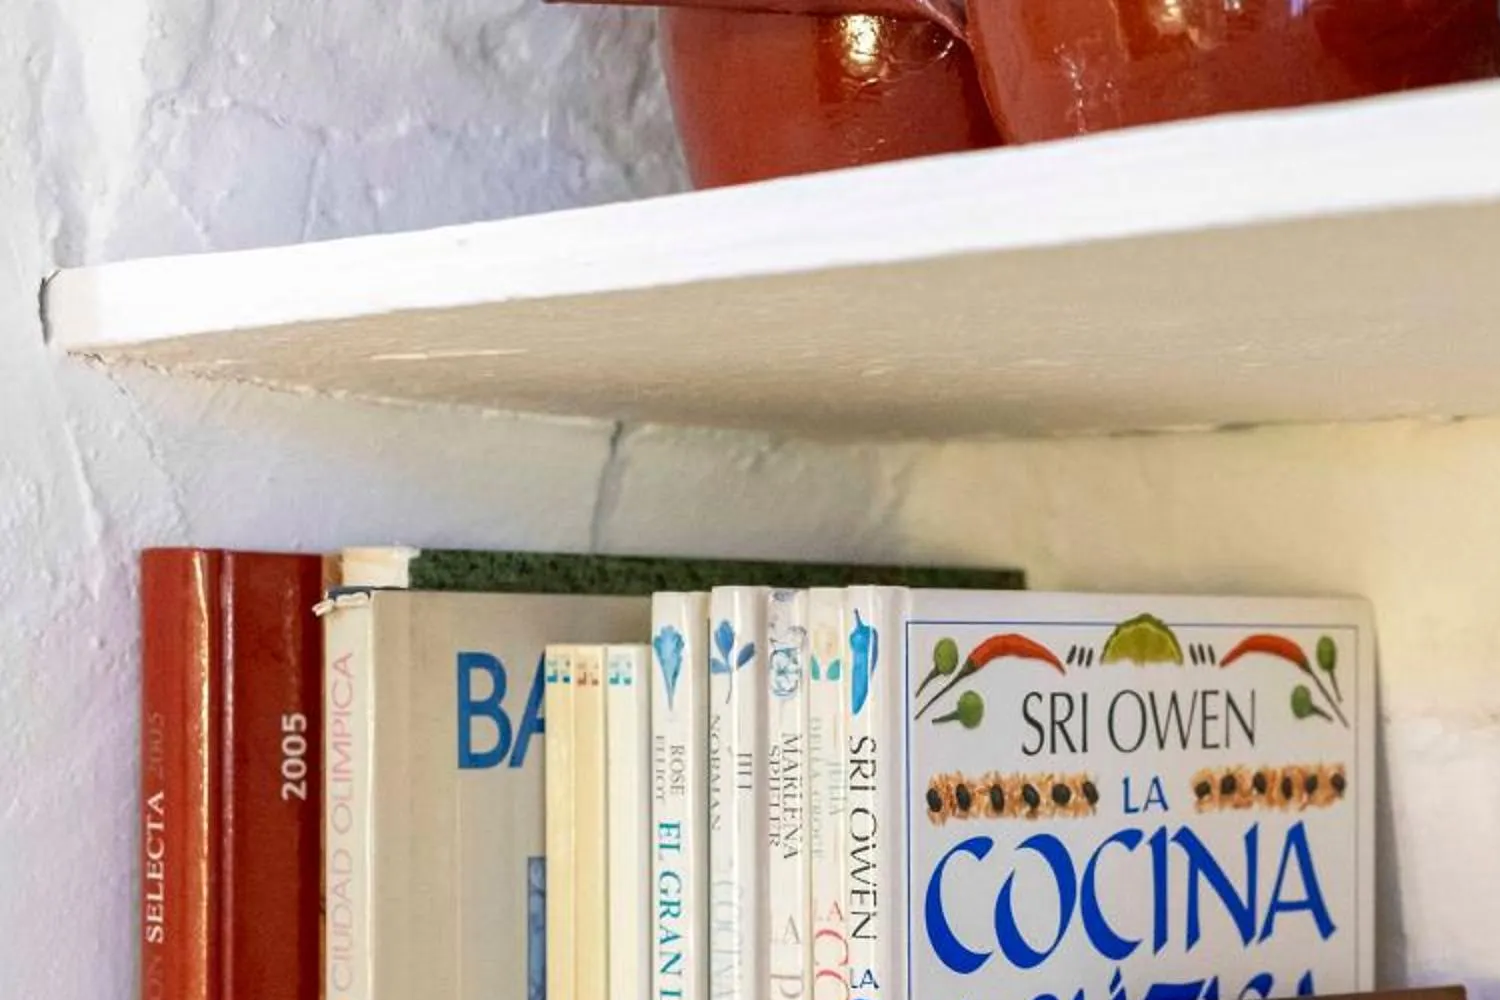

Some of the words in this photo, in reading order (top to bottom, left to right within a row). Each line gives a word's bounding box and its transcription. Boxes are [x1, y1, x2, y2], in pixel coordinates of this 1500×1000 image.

[280, 712, 308, 801] 2005
[670, 744, 686, 797] ROSE
[849, 735, 878, 791] SRI
[1021, 691, 1088, 756] SRI
[1107, 689, 1255, 753] OWEN
[710, 714, 721, 832] NORMAN
[769, 744, 781, 848] SPIELER
[782, 732, 803, 860] MARLENA
[828, 760, 849, 816] JULIA
[1122, 775, 1169, 815] LA
[145, 790, 166, 944] SELECTA
[658, 820, 682, 861] EL
[849, 807, 878, 940] OWEN
[330, 848, 354, 992] CIUDAD
[658, 871, 684, 977] GRAN
[924, 820, 1337, 975] COCINA
[850, 968, 880, 990] LA
